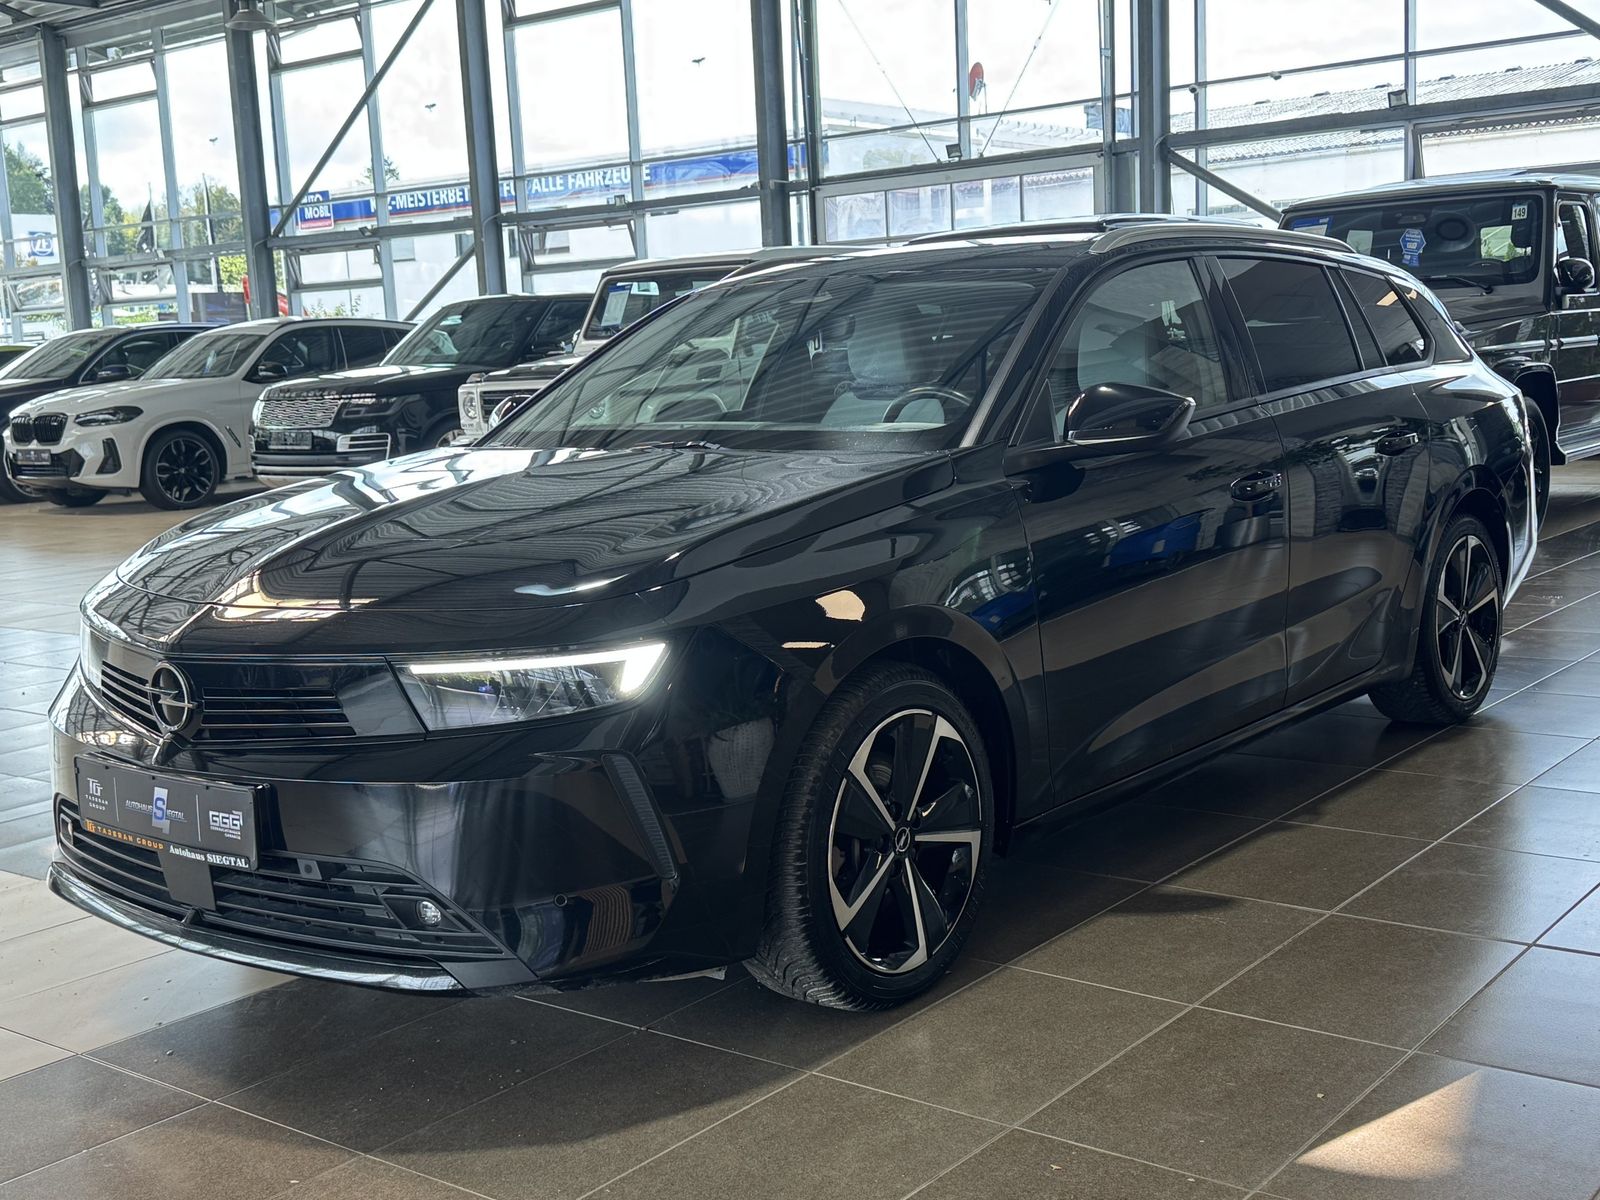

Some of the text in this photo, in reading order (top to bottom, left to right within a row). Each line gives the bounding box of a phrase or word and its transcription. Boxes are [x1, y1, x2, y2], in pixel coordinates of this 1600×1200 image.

[531, 175, 565, 194] ALLE
[567, 163, 651, 191] FAHRZEUE
[304, 205, 331, 219] MOBIL
[1513, 207, 1527, 219] 149
[125, 799, 153, 813] AUTOHAUS
[209, 810, 243, 830] GGG
[136, 837, 164, 850] GROUP
[169, 844, 249, 868] Autohaus SIEGTAL
